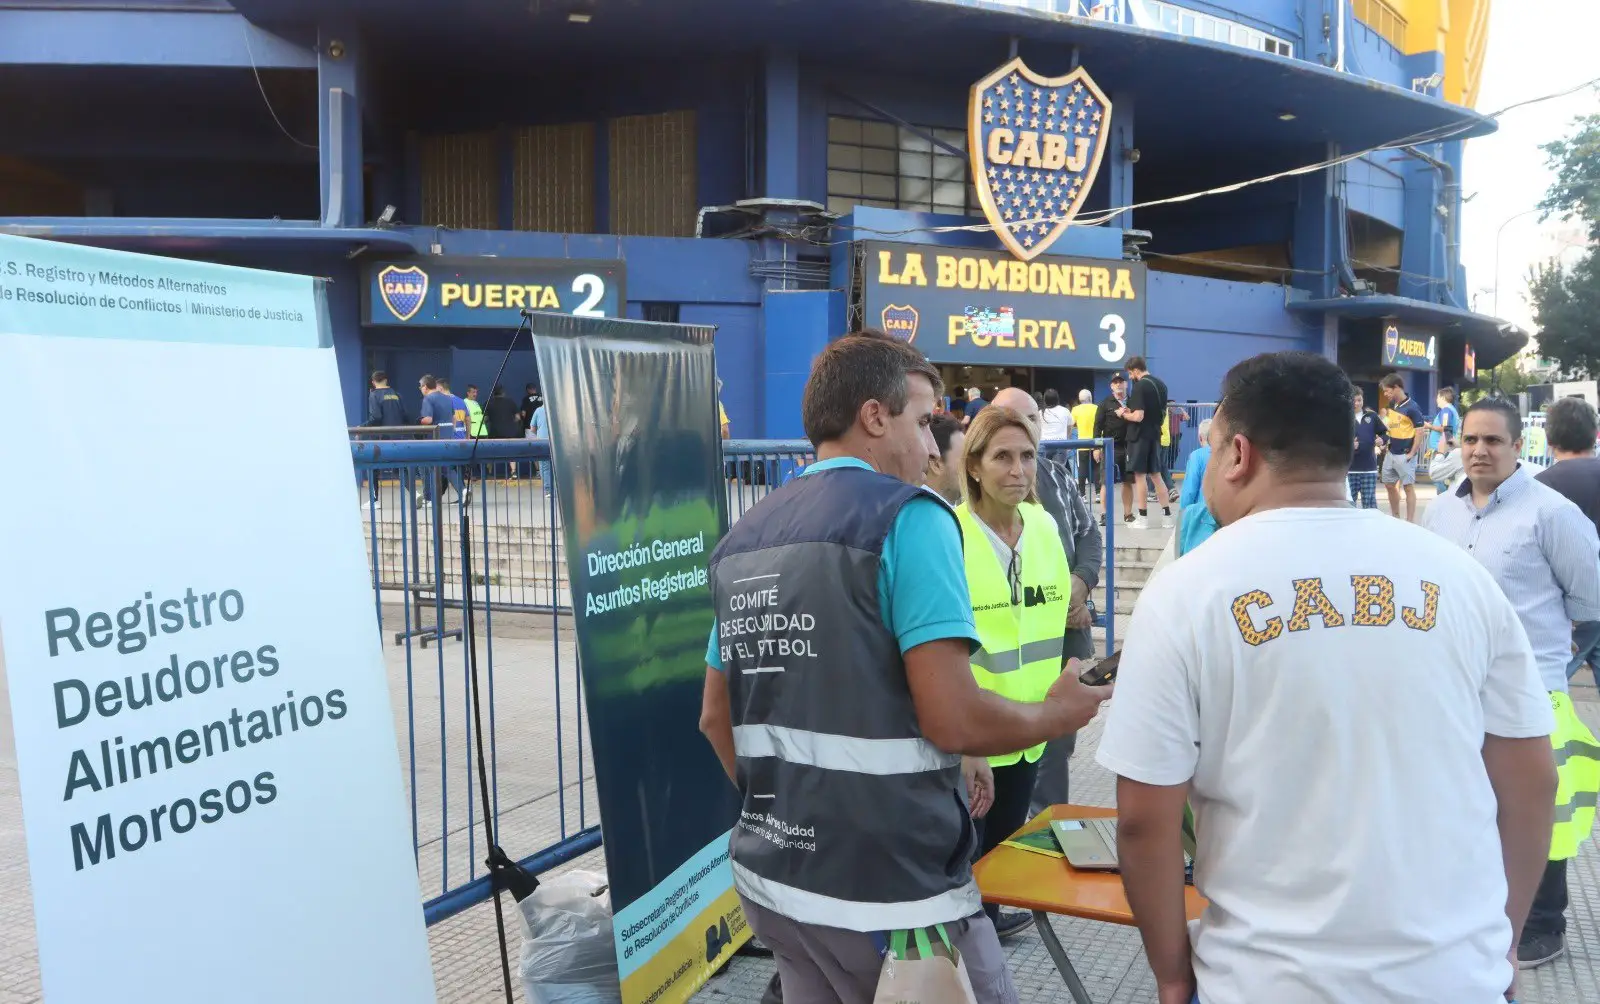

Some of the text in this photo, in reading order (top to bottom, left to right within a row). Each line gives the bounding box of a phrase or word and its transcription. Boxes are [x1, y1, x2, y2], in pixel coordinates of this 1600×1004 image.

[987, 128, 1090, 173] CABJ
[26, 263, 85, 283] Registro
[88, 273, 96, 286] y
[99, 271, 155, 289] Métodos
[157, 278, 227, 295] Alternativos
[385, 282, 422, 295] CABJ
[878, 251, 1135, 300] LA BOMBONERA
[16, 287, 97, 307] Resolución
[100, 294, 116, 309] de
[118, 296, 182, 314] Conflictos
[191, 302, 246, 319] Ministerio
[248, 307, 261, 319] de
[263, 308, 304, 322] Justicia
[441, 273, 605, 317] PUERTA 2
[886, 319, 914, 330] CABJ
[1098, 314, 1126, 362] 3
[1400, 335, 1436, 366] PUERTA 4
[587, 530, 704, 577] Dirección General
[585, 584, 641, 617] Asuntos
[730, 585, 779, 612] COMITÉ
[1230, 575, 1441, 646] CABJ
[45, 587, 245, 657] Registro
[735, 642, 755, 658] EL
[757, 638, 818, 657] FTBOL
[53, 644, 280, 729] Deudores
[63, 688, 348, 802] Alimentarios
[70, 771, 278, 872] Morosos
[781, 820, 815, 837] Ciudad
[772, 833, 816, 851] Seguridad
[624, 945, 634, 960] de
